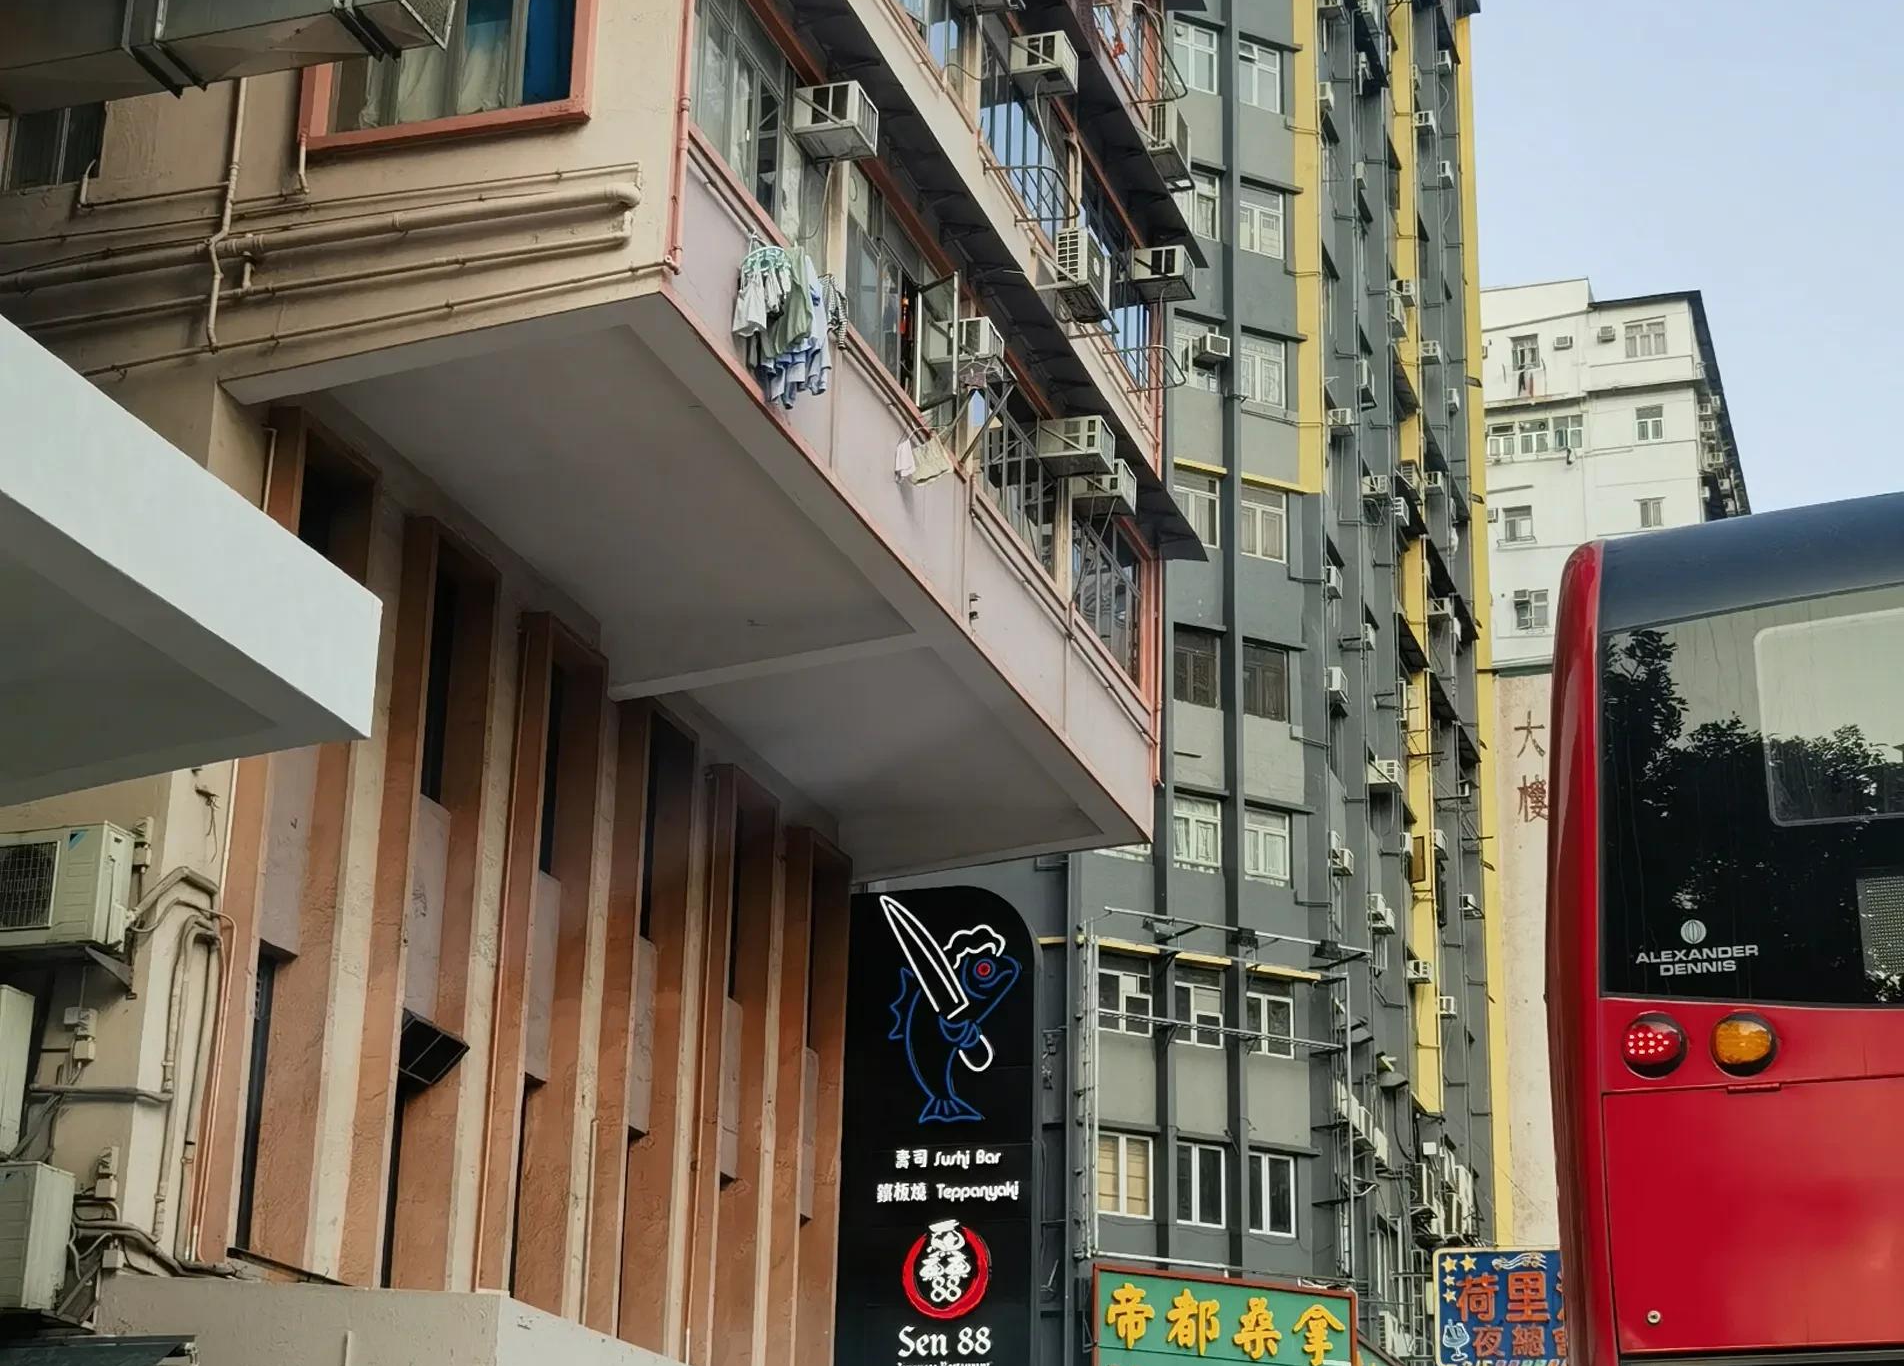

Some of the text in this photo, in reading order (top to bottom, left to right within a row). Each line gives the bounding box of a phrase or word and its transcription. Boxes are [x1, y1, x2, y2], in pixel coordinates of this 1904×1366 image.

[1635, 944, 1759, 964] ALEXANDER
[1659, 960, 1737, 976] DENNIS
[933, 1150, 970, 1169] Sushi
[975, 1149, 1001, 1164] Bar
[936, 1180, 1019, 1202] Teppanyaki
[1456, 1270, 1565, 1323] 荷里
[898, 1325, 992, 1357] Sen 88
